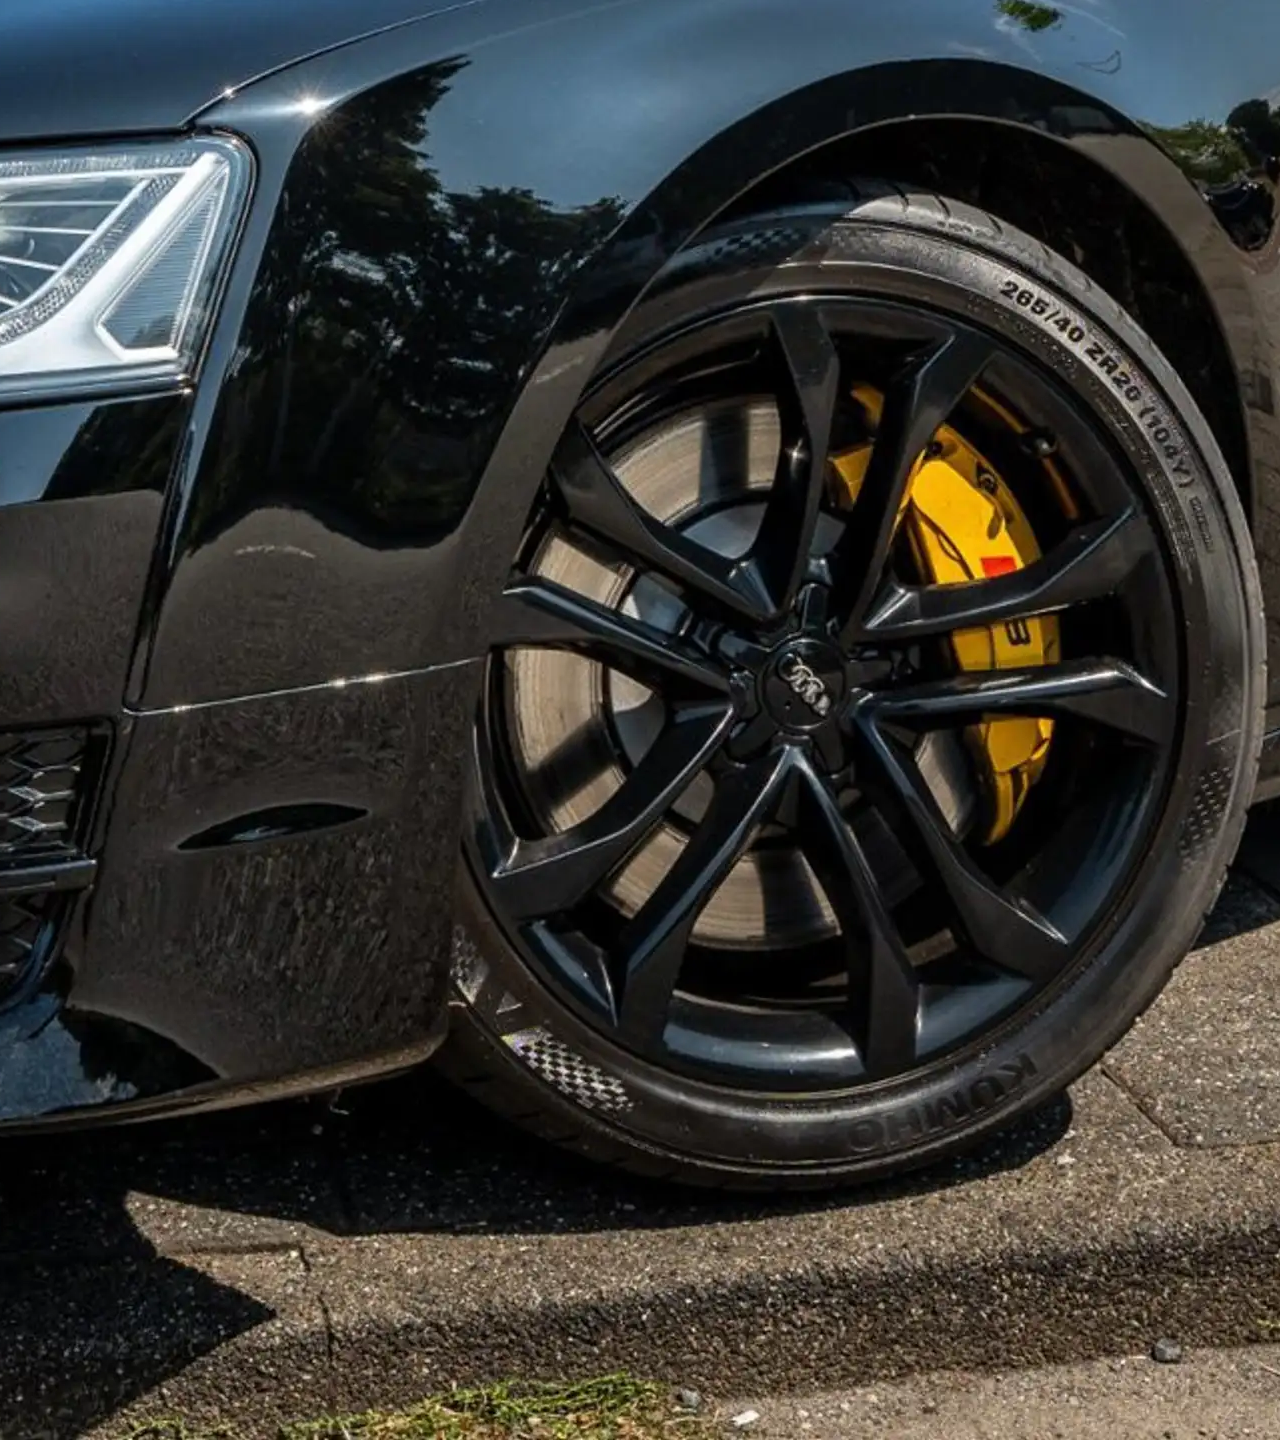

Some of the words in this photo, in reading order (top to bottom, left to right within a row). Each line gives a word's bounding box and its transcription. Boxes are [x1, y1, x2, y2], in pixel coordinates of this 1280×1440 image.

[999, 279, 1085, 344] 265/40
[1083, 339, 1140, 402] ZR20
[1137, 406, 1194, 489] (104Y)
[847, 1052, 1038, 1153] KUMHO
